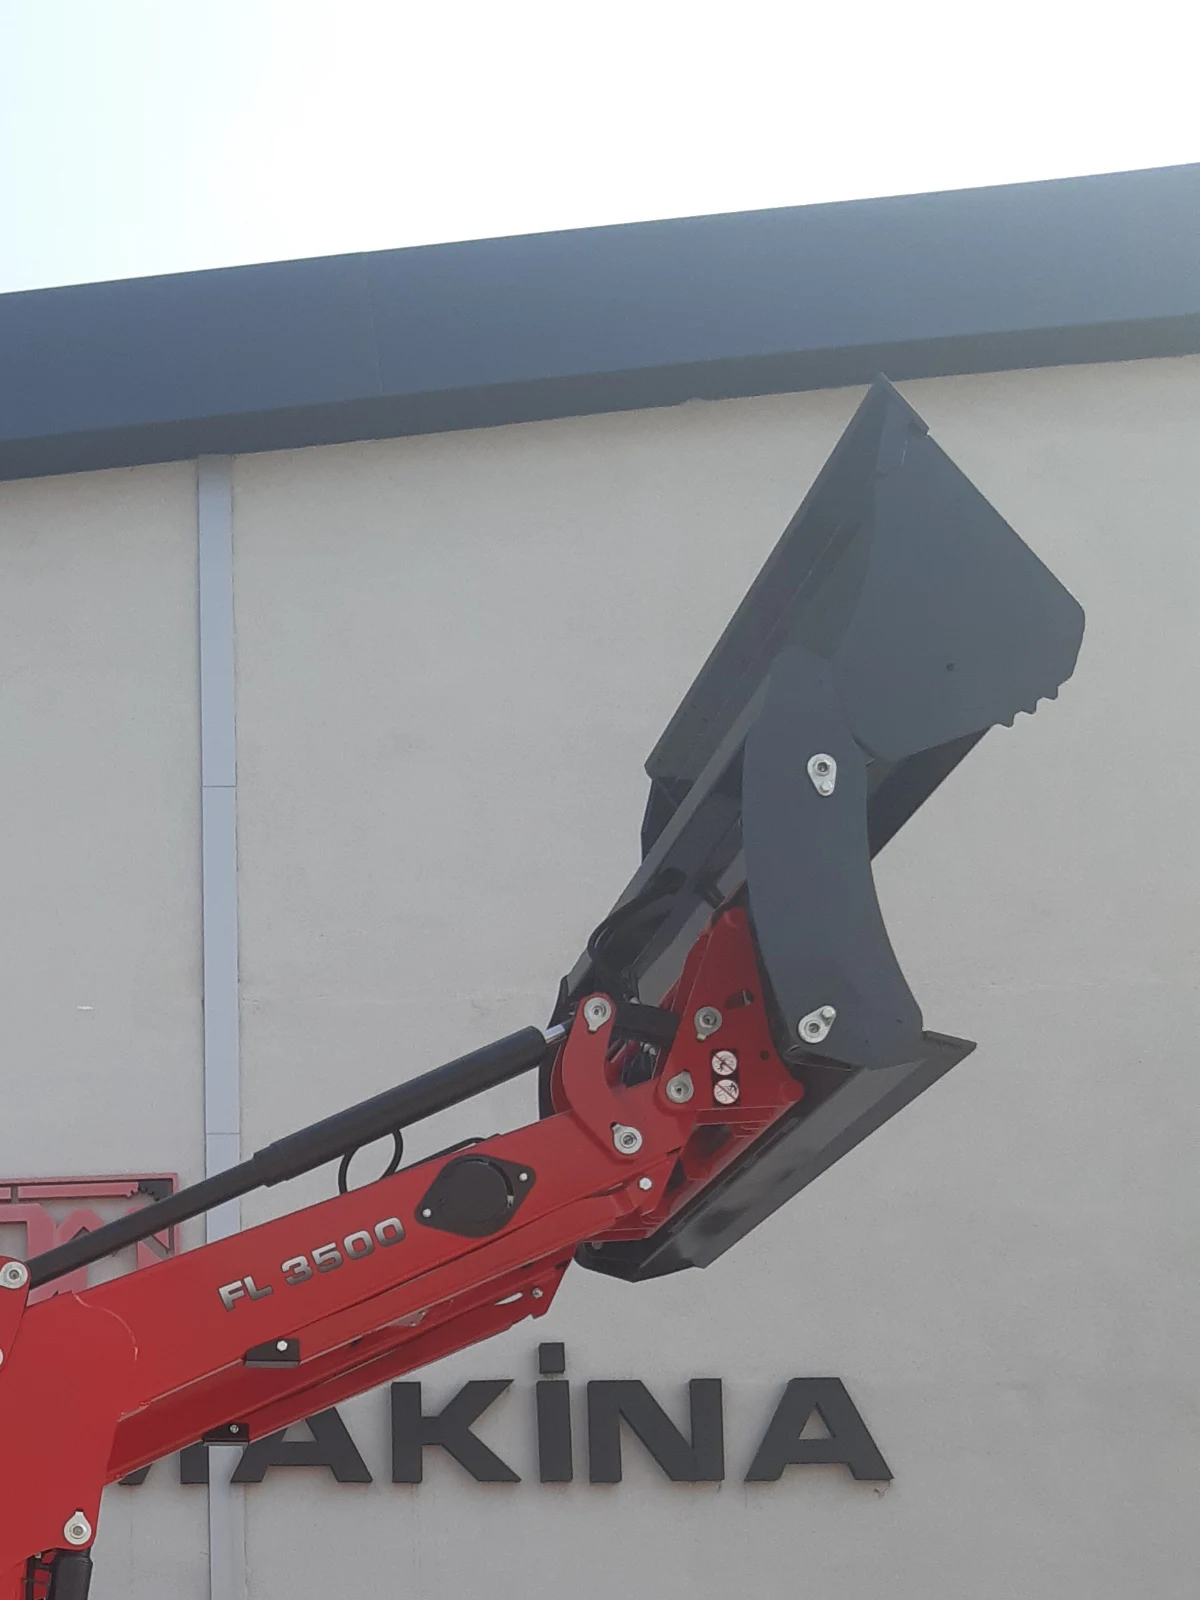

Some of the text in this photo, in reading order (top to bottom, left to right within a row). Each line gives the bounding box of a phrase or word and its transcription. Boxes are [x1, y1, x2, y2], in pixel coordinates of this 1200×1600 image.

[218, 1217, 406, 1312] FL 3500
[118, 1342, 894, 1484] AKİNA
